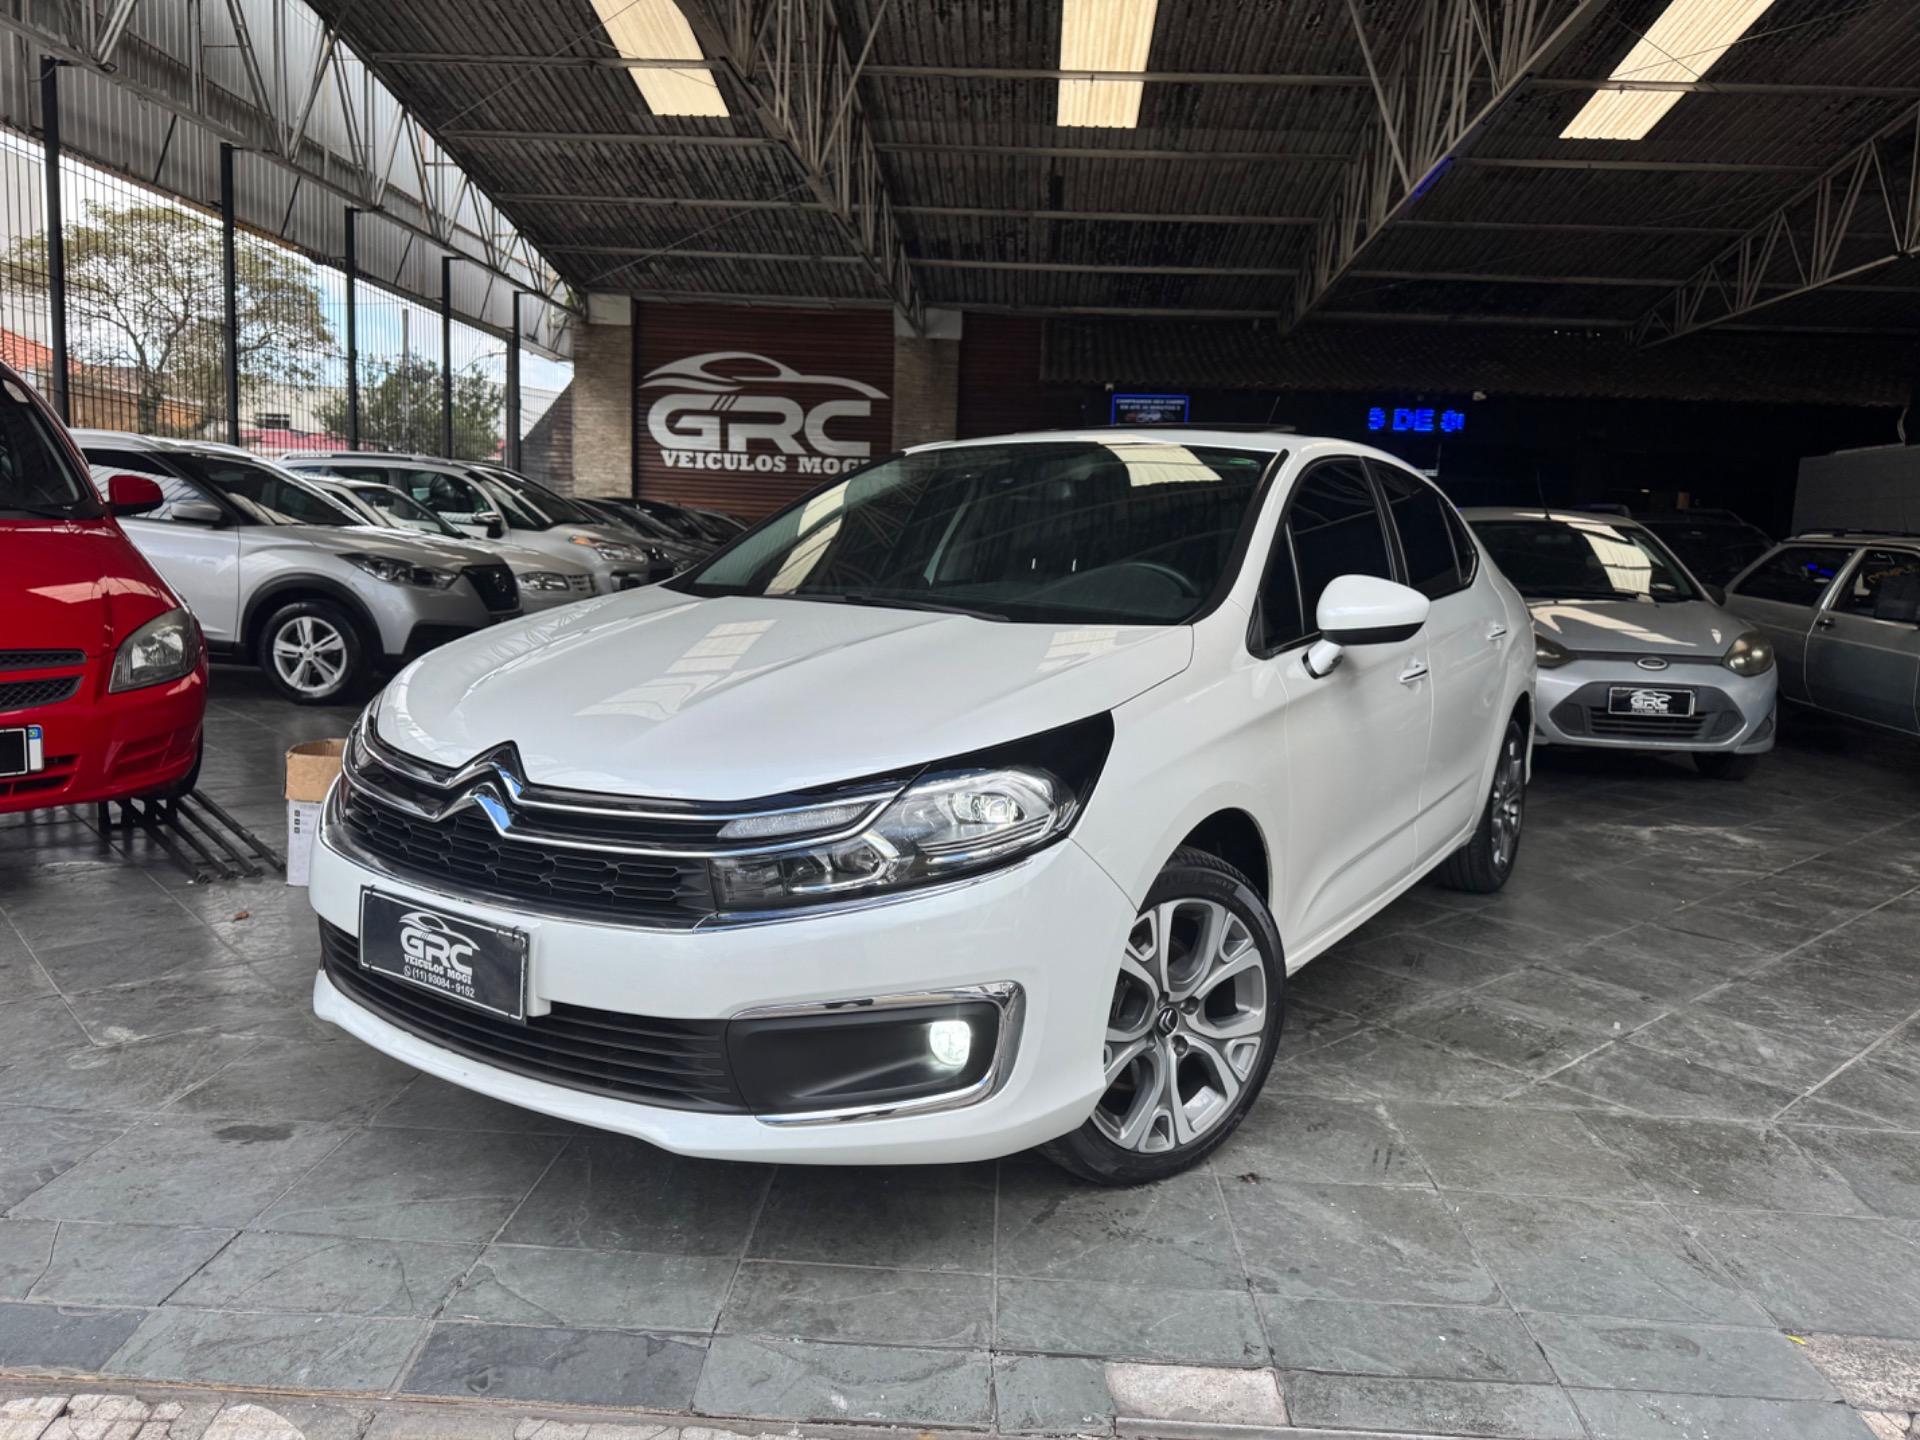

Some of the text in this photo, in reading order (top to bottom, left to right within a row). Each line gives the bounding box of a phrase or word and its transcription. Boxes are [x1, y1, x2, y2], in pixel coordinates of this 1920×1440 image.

[647, 393, 871, 456] GRC
[660, 449, 786, 473] VEICULOS
[400, 926, 473, 977] GRC
[404, 953, 445, 976] VEICULOS
